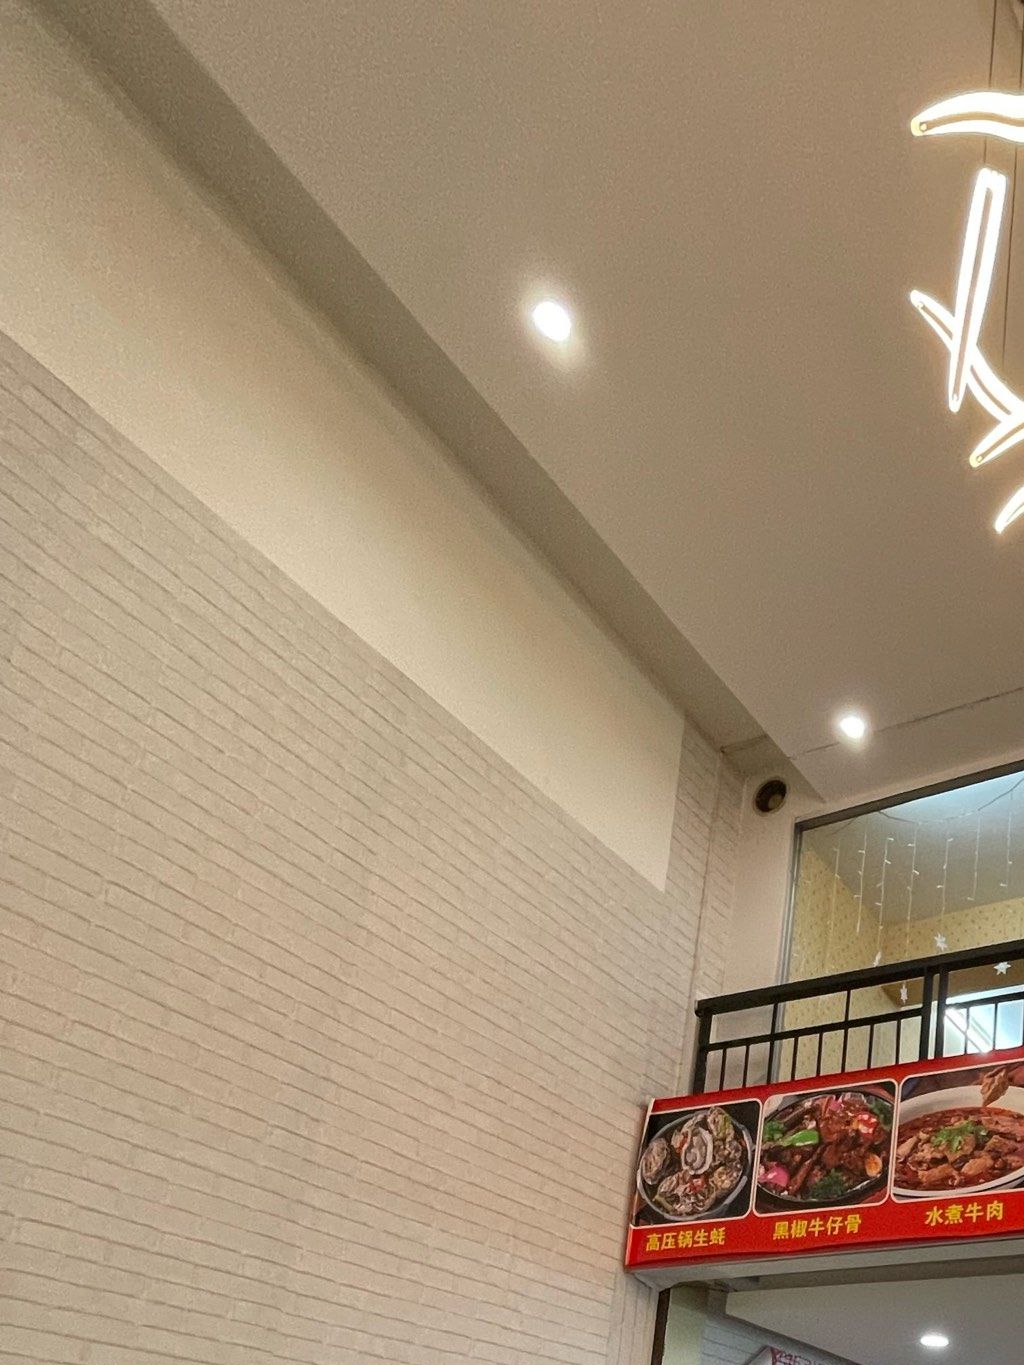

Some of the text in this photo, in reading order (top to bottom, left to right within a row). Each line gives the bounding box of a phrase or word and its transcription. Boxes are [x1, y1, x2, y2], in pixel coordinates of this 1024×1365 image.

[924, 1200, 1004, 1226] 水煮牛肉
[645, 1227, 726, 1251] 高压锅生蚝
[773, 1214, 862, 1240] 黑椒牛仔骨
